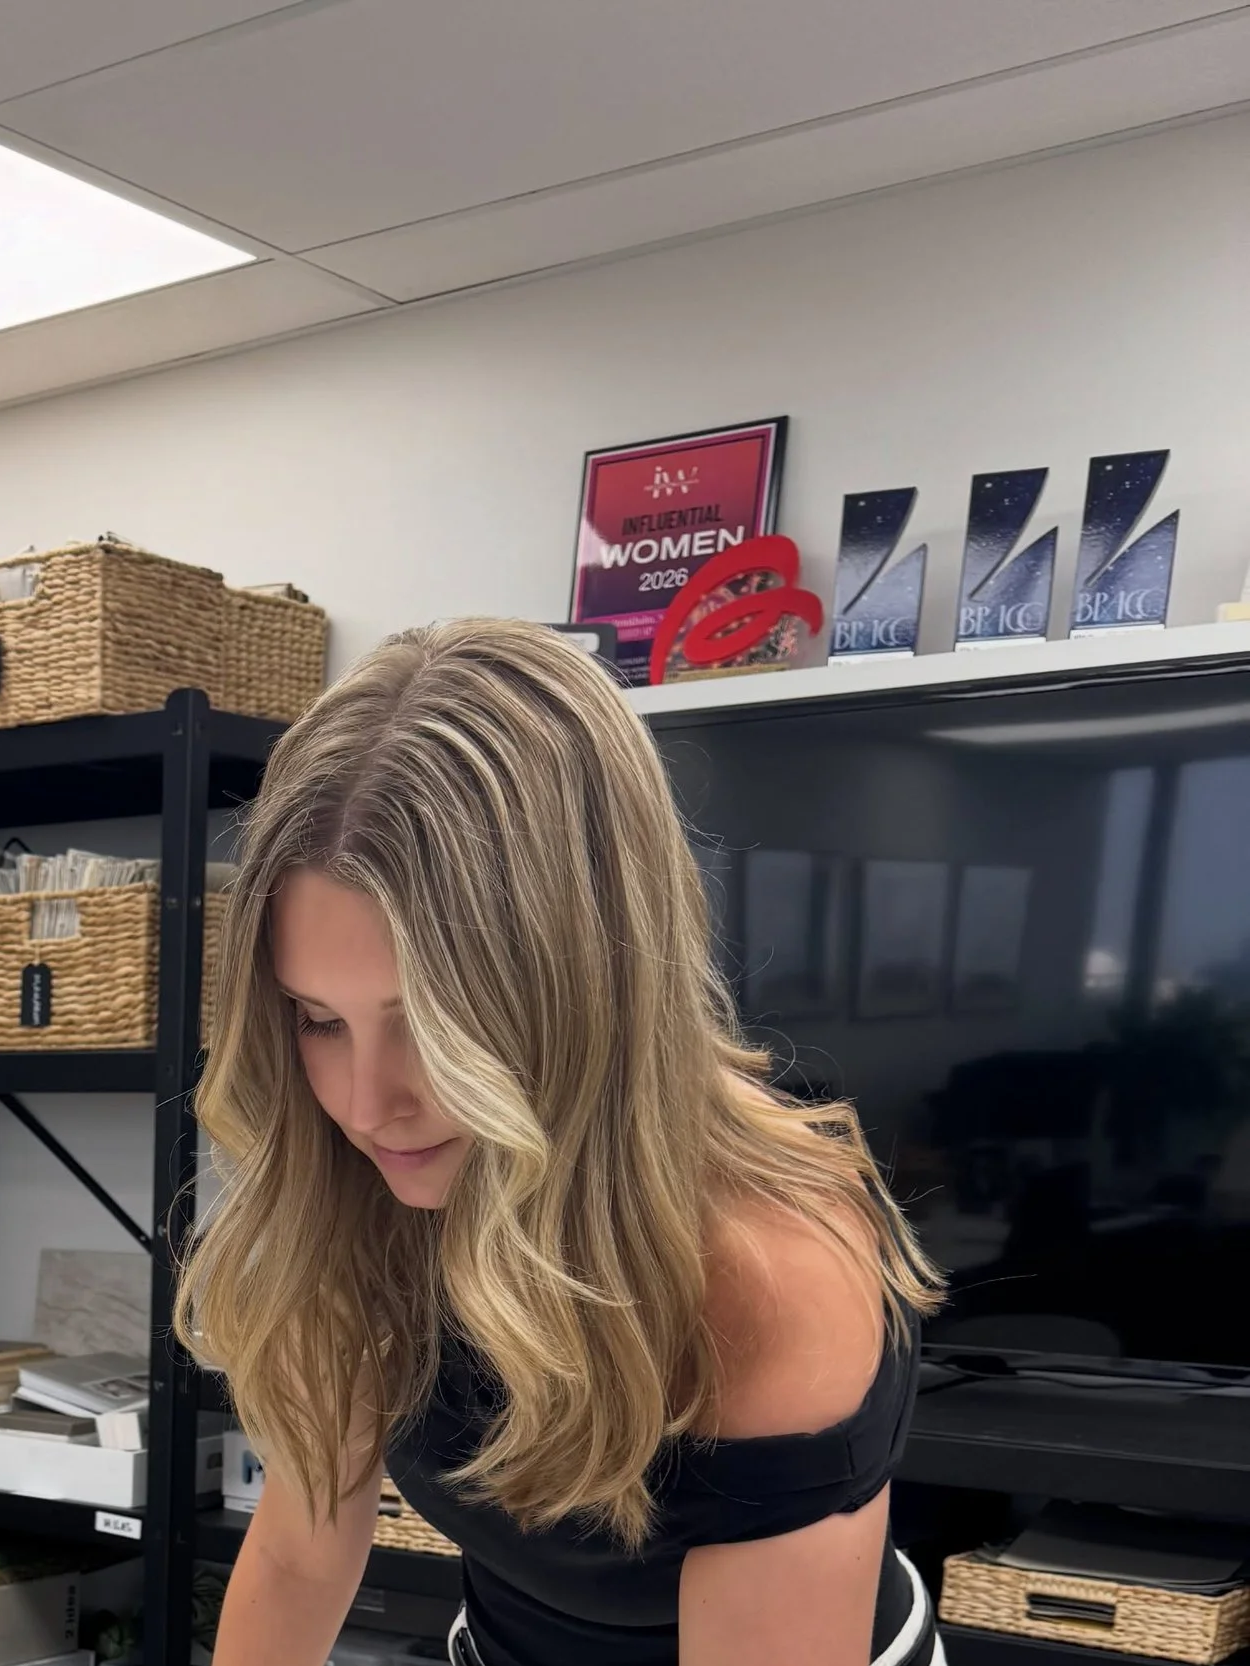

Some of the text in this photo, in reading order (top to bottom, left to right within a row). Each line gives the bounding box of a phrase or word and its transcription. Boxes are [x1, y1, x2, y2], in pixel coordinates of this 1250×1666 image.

[621, 504, 724, 537] INFLUENTIAL
[600, 525, 745, 569] WOMEN
[638, 567, 689, 592] 2026
